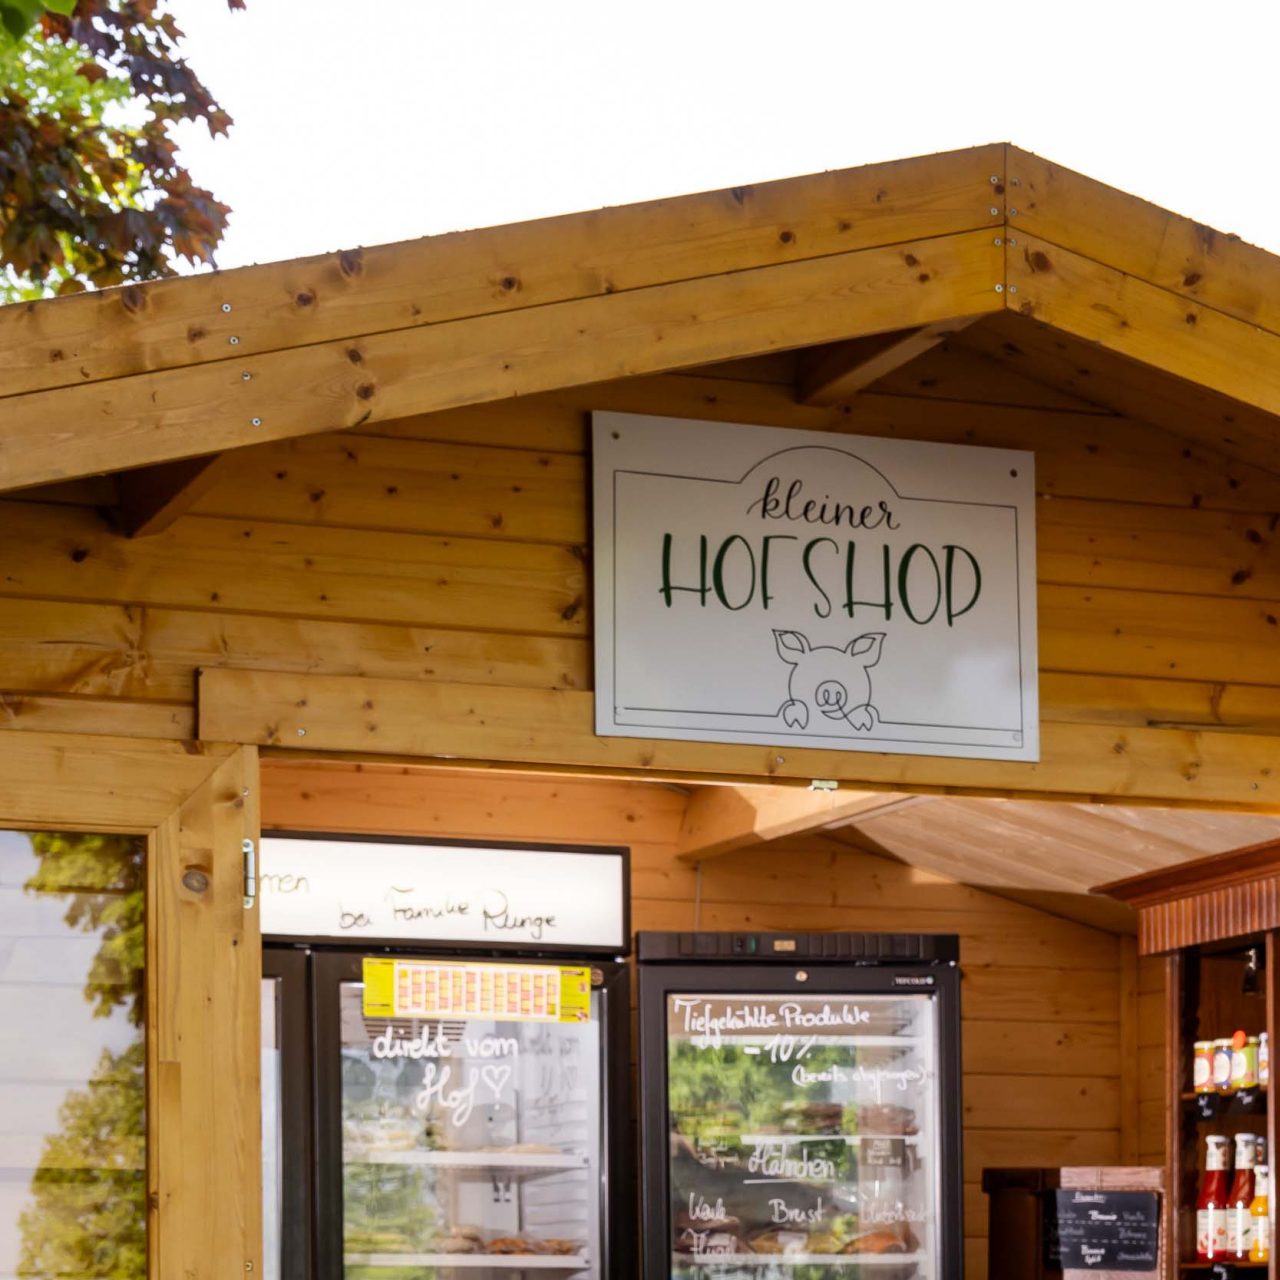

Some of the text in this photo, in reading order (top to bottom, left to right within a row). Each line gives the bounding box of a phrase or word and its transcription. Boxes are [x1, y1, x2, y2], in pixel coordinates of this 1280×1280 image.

[746, 477, 901, 530] kleiner
[658, 532, 982, 628] HOFSHOP
[384, 886, 470, 921] Familie
[482, 889, 558, 939] Runge
[373, 1023, 519, 1059] direkt vom
[779, 1002, 871, 1028] Produkte
[416, 1063, 479, 1127] Hof
